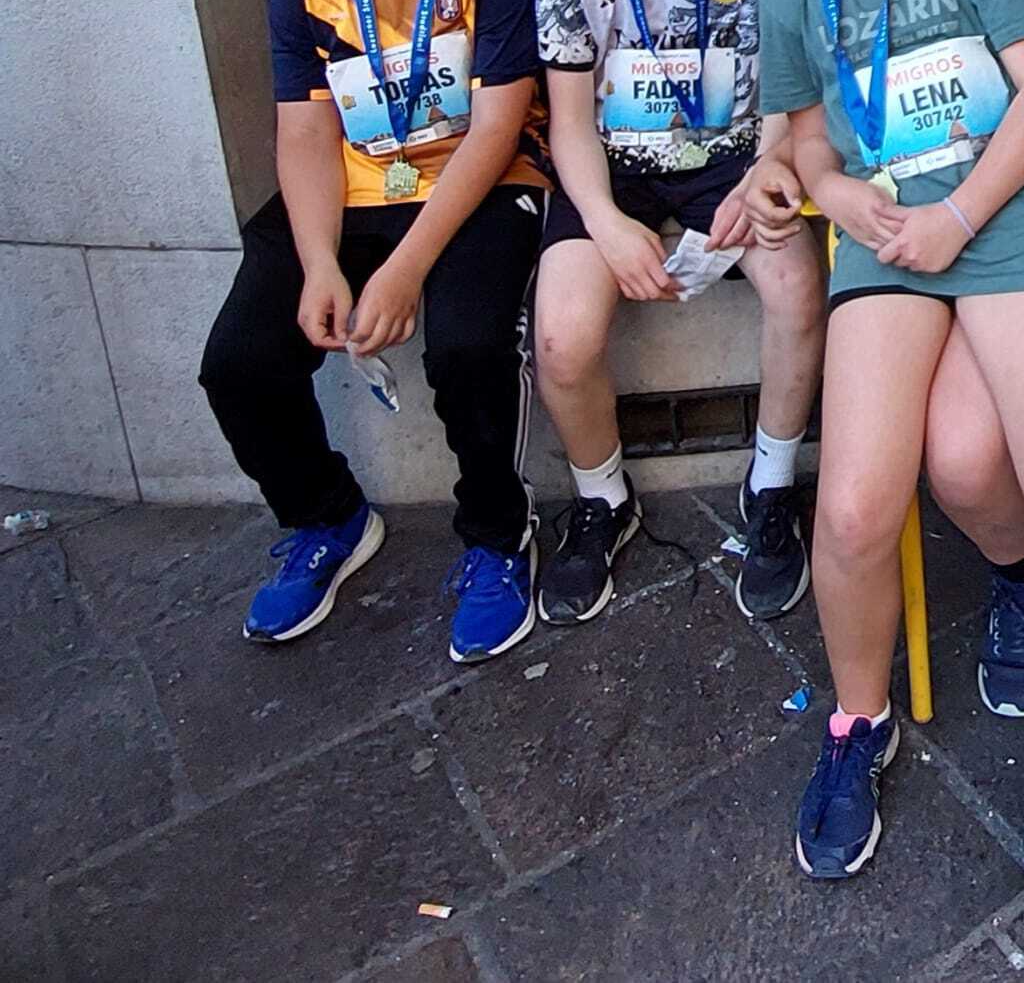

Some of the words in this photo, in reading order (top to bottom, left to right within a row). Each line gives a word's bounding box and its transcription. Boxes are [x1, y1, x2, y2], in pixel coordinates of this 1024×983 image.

[632, 62, 698, 75] MIGROS
[887, 54, 964, 88] MIGROS
[899, 78, 968, 116] LENA
[912, 105, 965, 131] 30742
